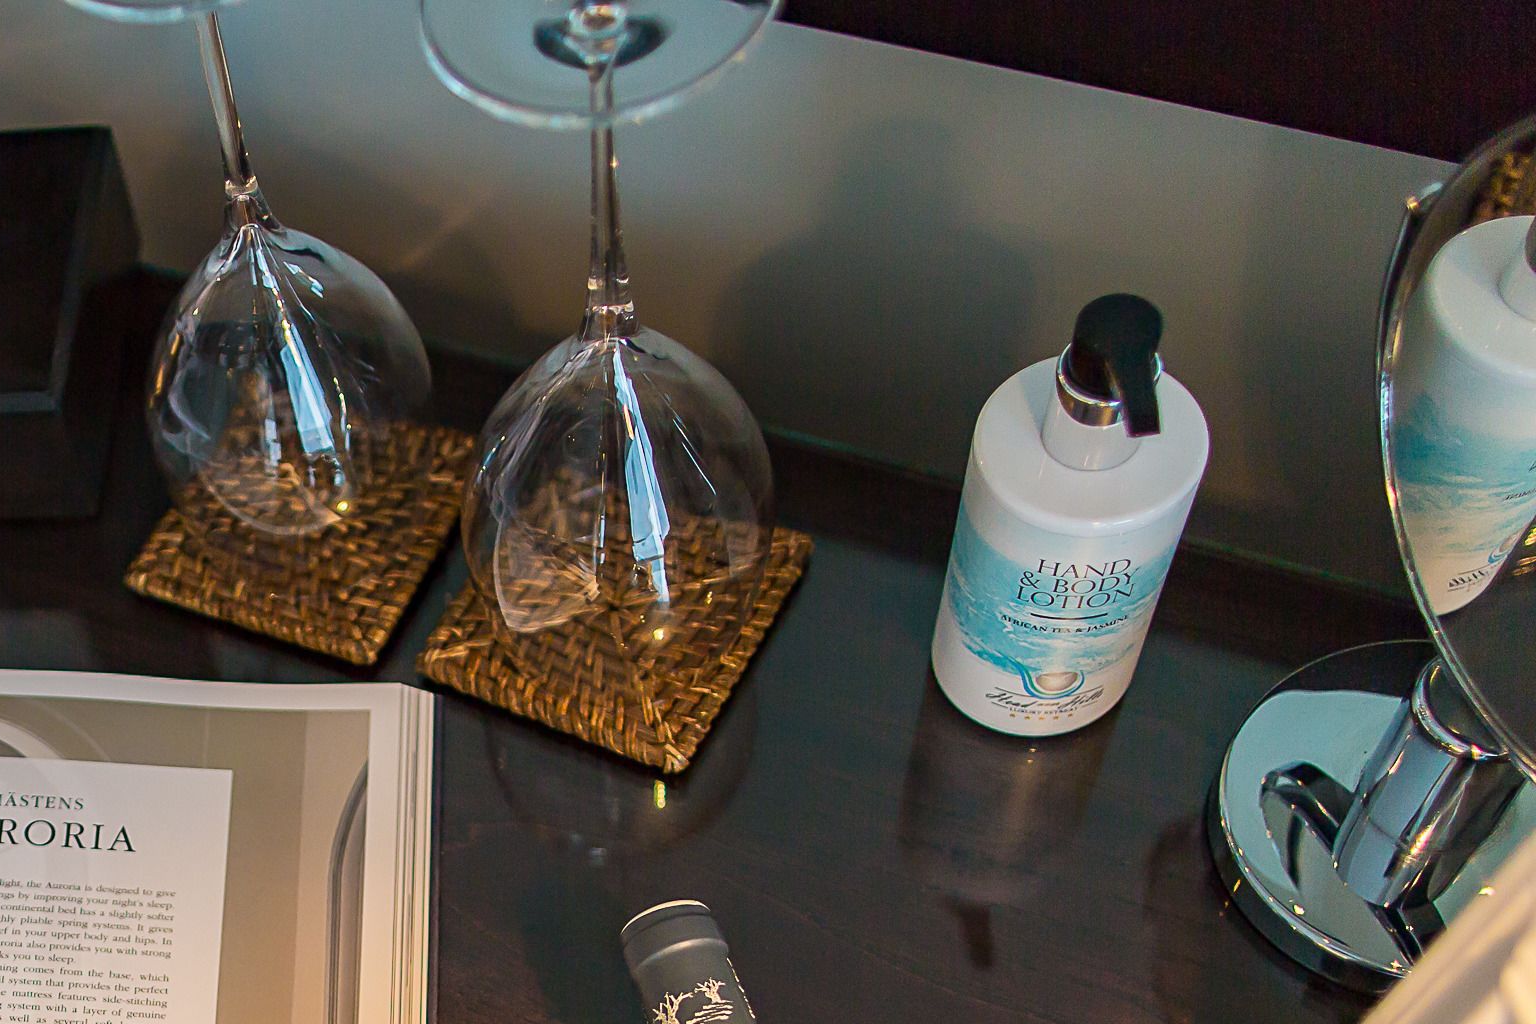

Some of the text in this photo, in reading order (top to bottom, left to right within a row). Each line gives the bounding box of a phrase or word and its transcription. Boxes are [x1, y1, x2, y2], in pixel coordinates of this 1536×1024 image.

[1036, 558, 1132, 579] HAND
[1019, 567, 1140, 594] & BODY
[1016, 585, 1135, 609] LOTION
[26, 880, 41, 888] the
[95, 884, 139, 896] designed
[155, 889, 175, 898] give
[17, 891, 29, 901] by
[33, 893, 83, 904] improving
[85, 897, 108, 906] your
[0, 902, 54, 912] continental
[57, 905, 76, 914] bed
[79, 907, 96, 915] has
[108, 909, 143, 920] slightly
[19, 916, 53, 927] pliable
[57, 919, 88, 929] spring
[136, 923, 144, 931] It
[148, 925, 173, 934] gives
[24, 929, 46, 938] your
[50, 931, 80, 940] upper
[83, 931, 108, 942] body
[112, 933, 131, 942] and
[161, 936, 172, 944] In
[12, 953, 31, 962] you
[26, 940, 46, 948] also
[48, 941, 91, 953] provides
[93, 946, 112, 955] you
[115, 946, 138, 954] with
[140, 948, 171, 958] strong
[59, 967, 83, 975] from
[87, 969, 104, 977] the
[139, 972, 169, 981] which
[7, 977, 42, 987] system
[45, 978, 64, 987] that
[67, 980, 111, 992] provides
[114, 983, 129, 991] the
[133, 984, 168, 995] perfect
[11, 990, 52, 998] mattress
[57, 991, 96, 1001] features
[6, 1002, 41, 1012] system
[45, 1003, 67, 1012] with
[82, 1006, 106, 1017] layer
[126, 1010, 166, 1020] genuine
[8, 1014, 29, 1022] well
